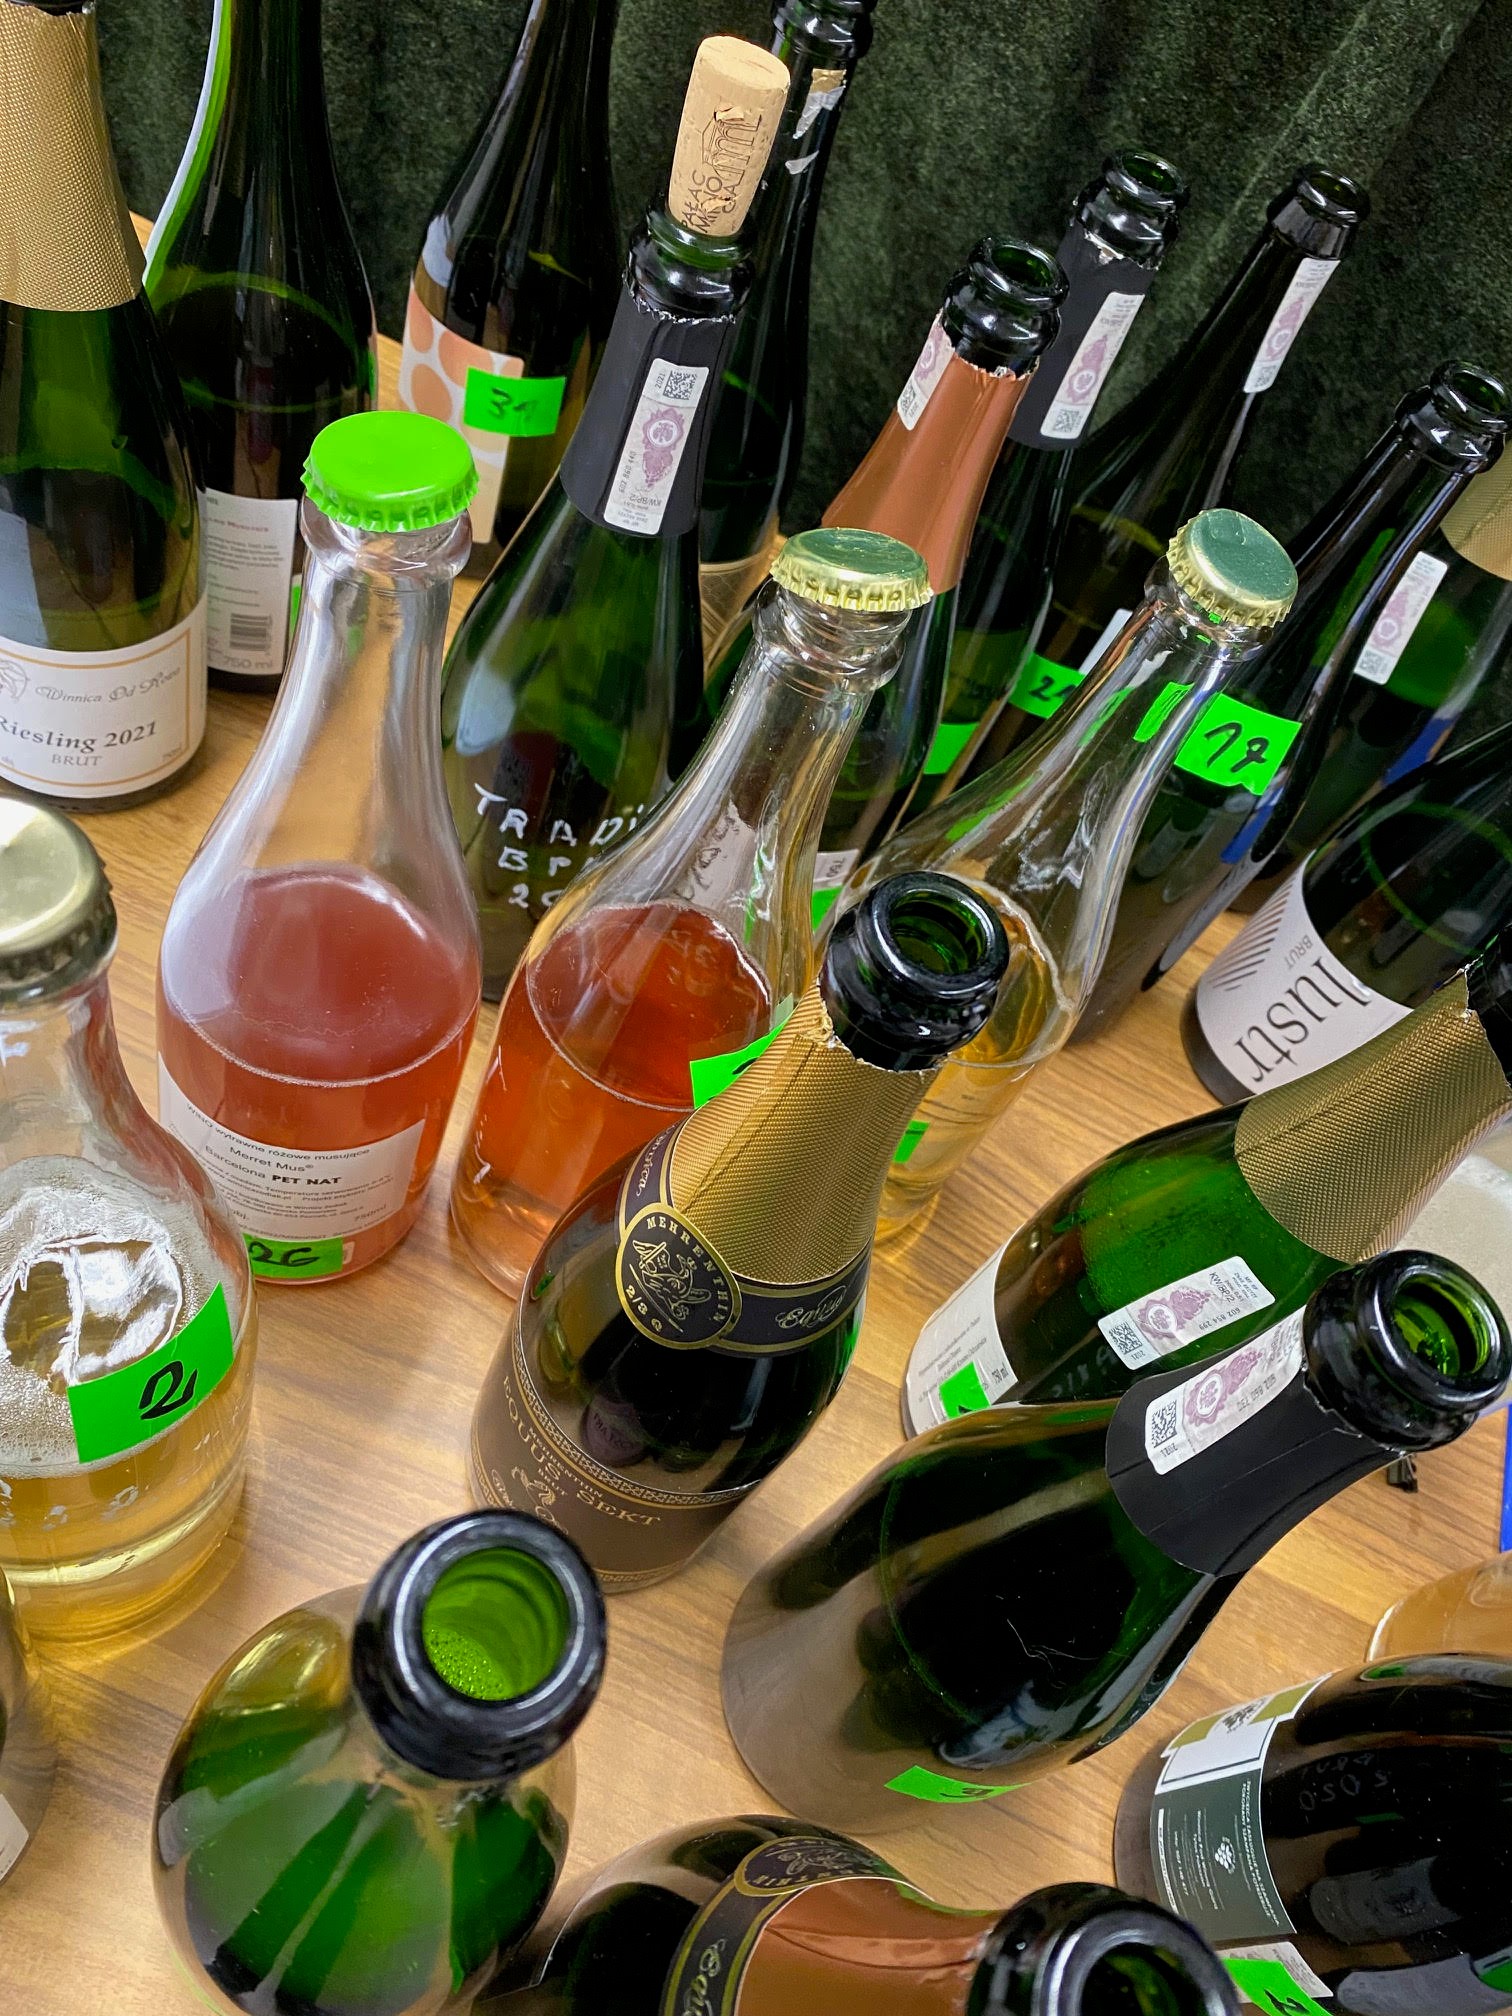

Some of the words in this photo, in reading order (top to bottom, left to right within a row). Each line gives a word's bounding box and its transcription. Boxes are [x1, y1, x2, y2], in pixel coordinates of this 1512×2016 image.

[103, 719, 157, 749] 2021
[51, 753, 104, 767] BRUT
[1283, 934, 1314, 970] BRUT
[215, 1127, 265, 1153] wytrawne
[230, 1146, 271, 1167] Merret
[205, 1145, 266, 1179] Barcelona
[271, 1174, 302, 1185] PET
[307, 1176, 342, 1185] NAT
[645, 1215, 729, 1322] MEHRENTHIN
[576, 1488, 662, 1526] SEKT
